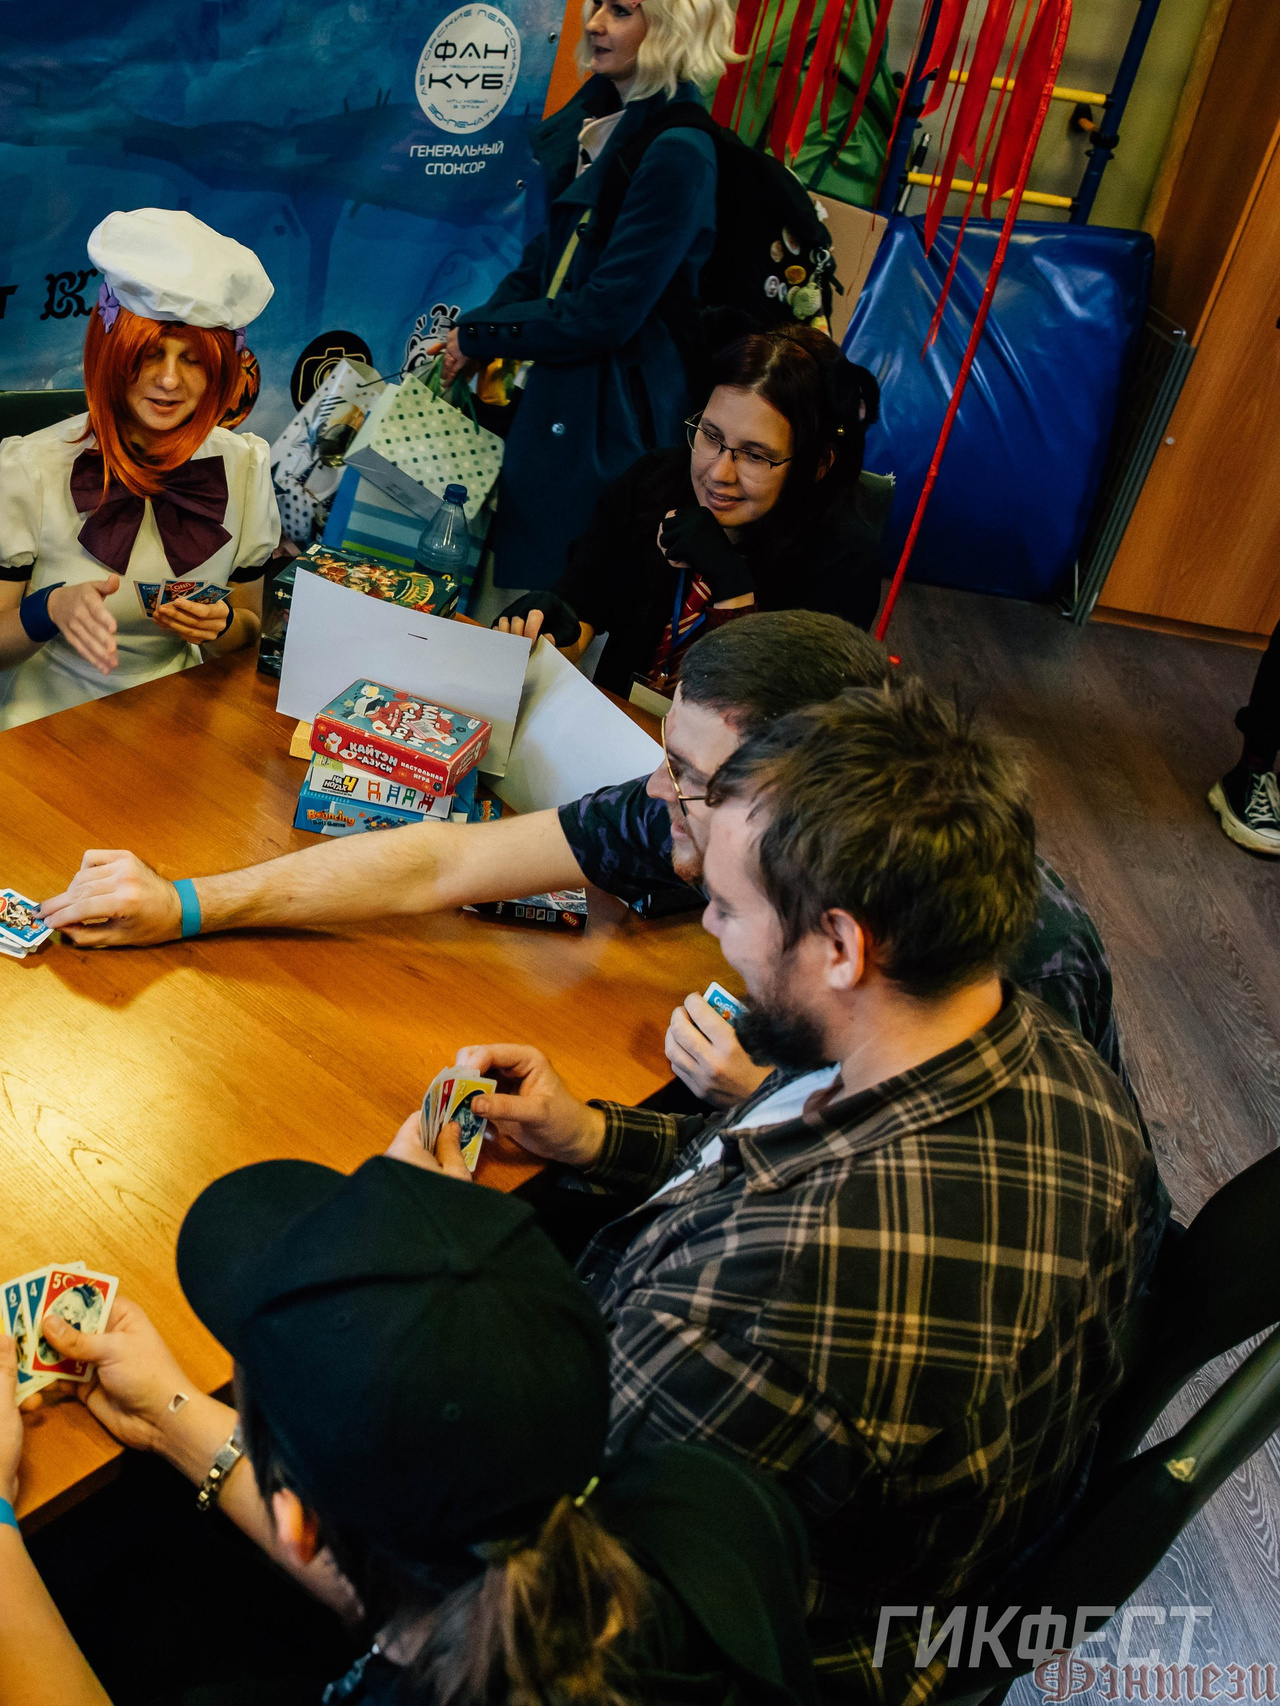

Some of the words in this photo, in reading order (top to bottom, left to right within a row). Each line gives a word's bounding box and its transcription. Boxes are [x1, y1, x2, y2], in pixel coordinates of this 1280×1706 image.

[434, 39, 509, 61] ФАН
[428, 72, 504, 90] КУБ
[409, 140, 505, 158] ГЕНЕРАЛЬНЫЙ
[425, 161, 486, 175] СПОНСОР
[349, 742, 398, 767] КАЙТЭН
[332, 775, 343, 784] НА
[400, 762, 444, 782] НАСТОЛЬНАЯ
[413, 773, 431, 784] ИГРА
[324, 780, 348, 792] НОГАХ
[307, 809, 356, 827] Bouncing
[29, 1281, 38, 1298] 4
[52, 1273, 63, 1289] 5
